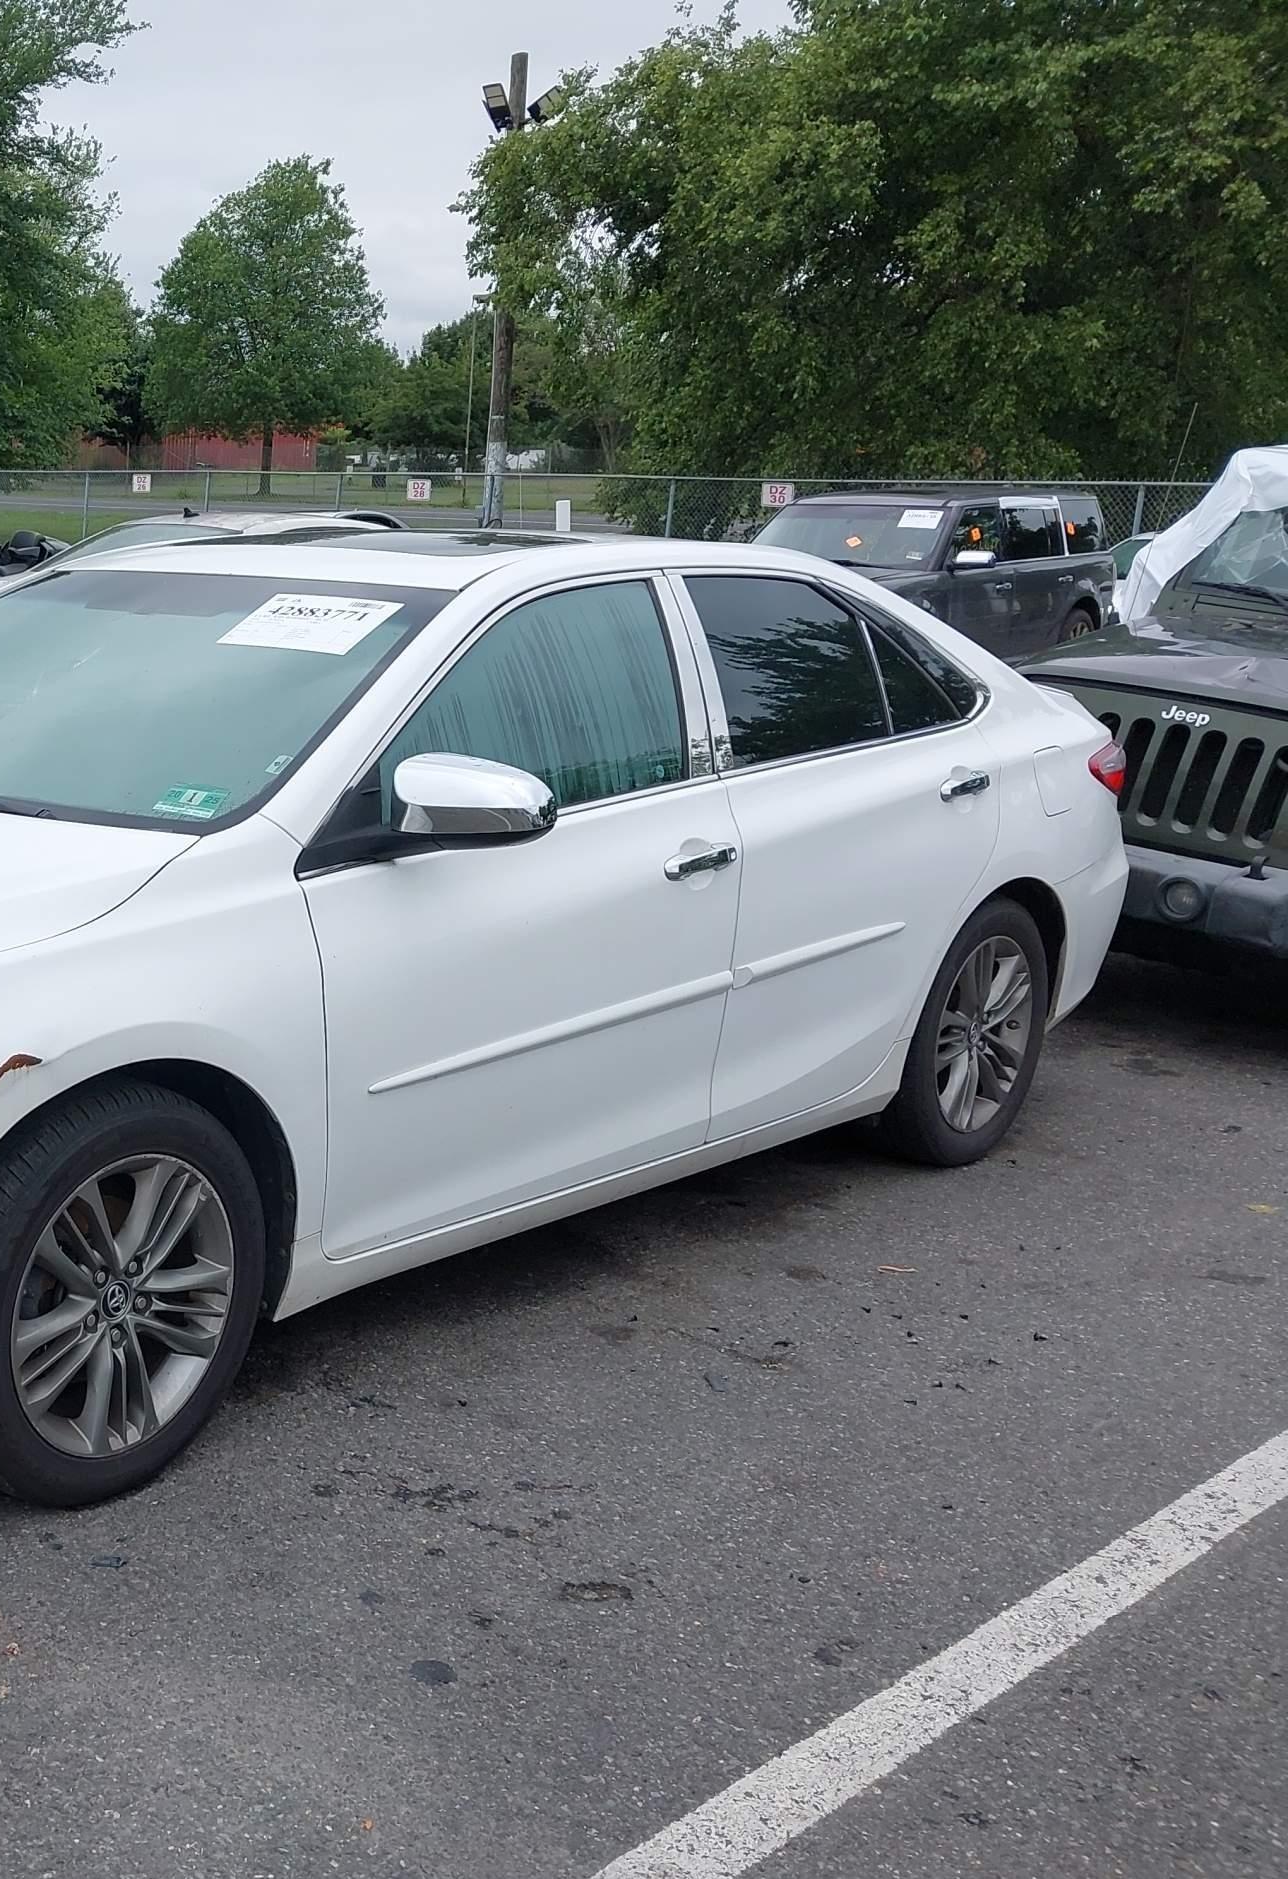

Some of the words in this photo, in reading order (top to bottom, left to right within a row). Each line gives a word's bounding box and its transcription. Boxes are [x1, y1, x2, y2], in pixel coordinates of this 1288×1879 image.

[413, 482, 426, 490] DZ
[769, 486, 787, 494] DZ
[413, 490, 425, 498] 28
[770, 495, 785, 504] 30
[268, 605, 369, 622] 42883771
[1161, 705, 1210, 727] Jeep
[187, 792, 198, 803] 1
